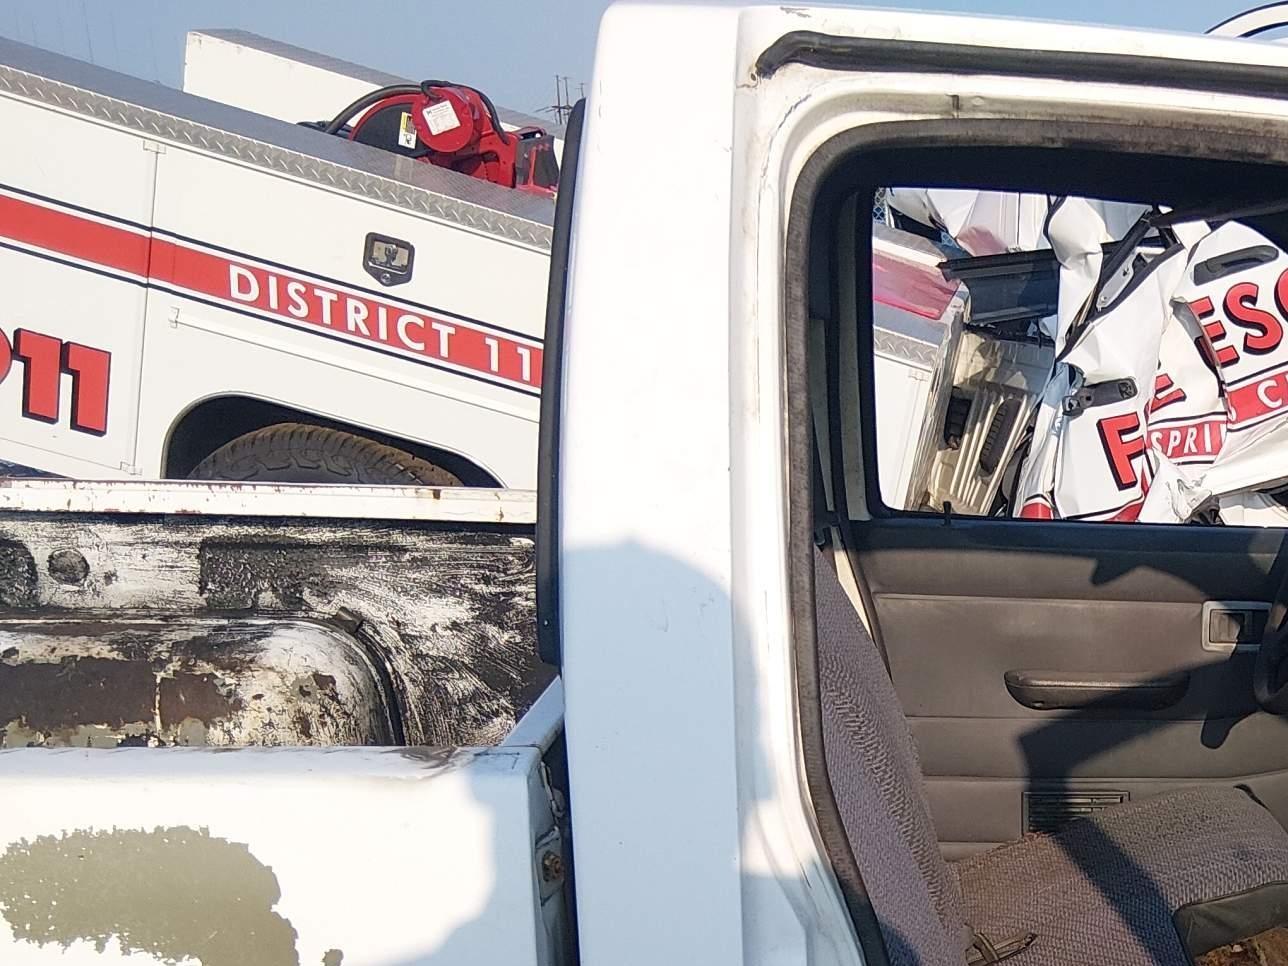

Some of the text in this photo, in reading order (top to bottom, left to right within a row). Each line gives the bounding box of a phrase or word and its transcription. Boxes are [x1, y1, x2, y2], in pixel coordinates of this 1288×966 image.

[229, 264, 531, 381] DISTRICT 11
[0, 327, 111, 437] 11
